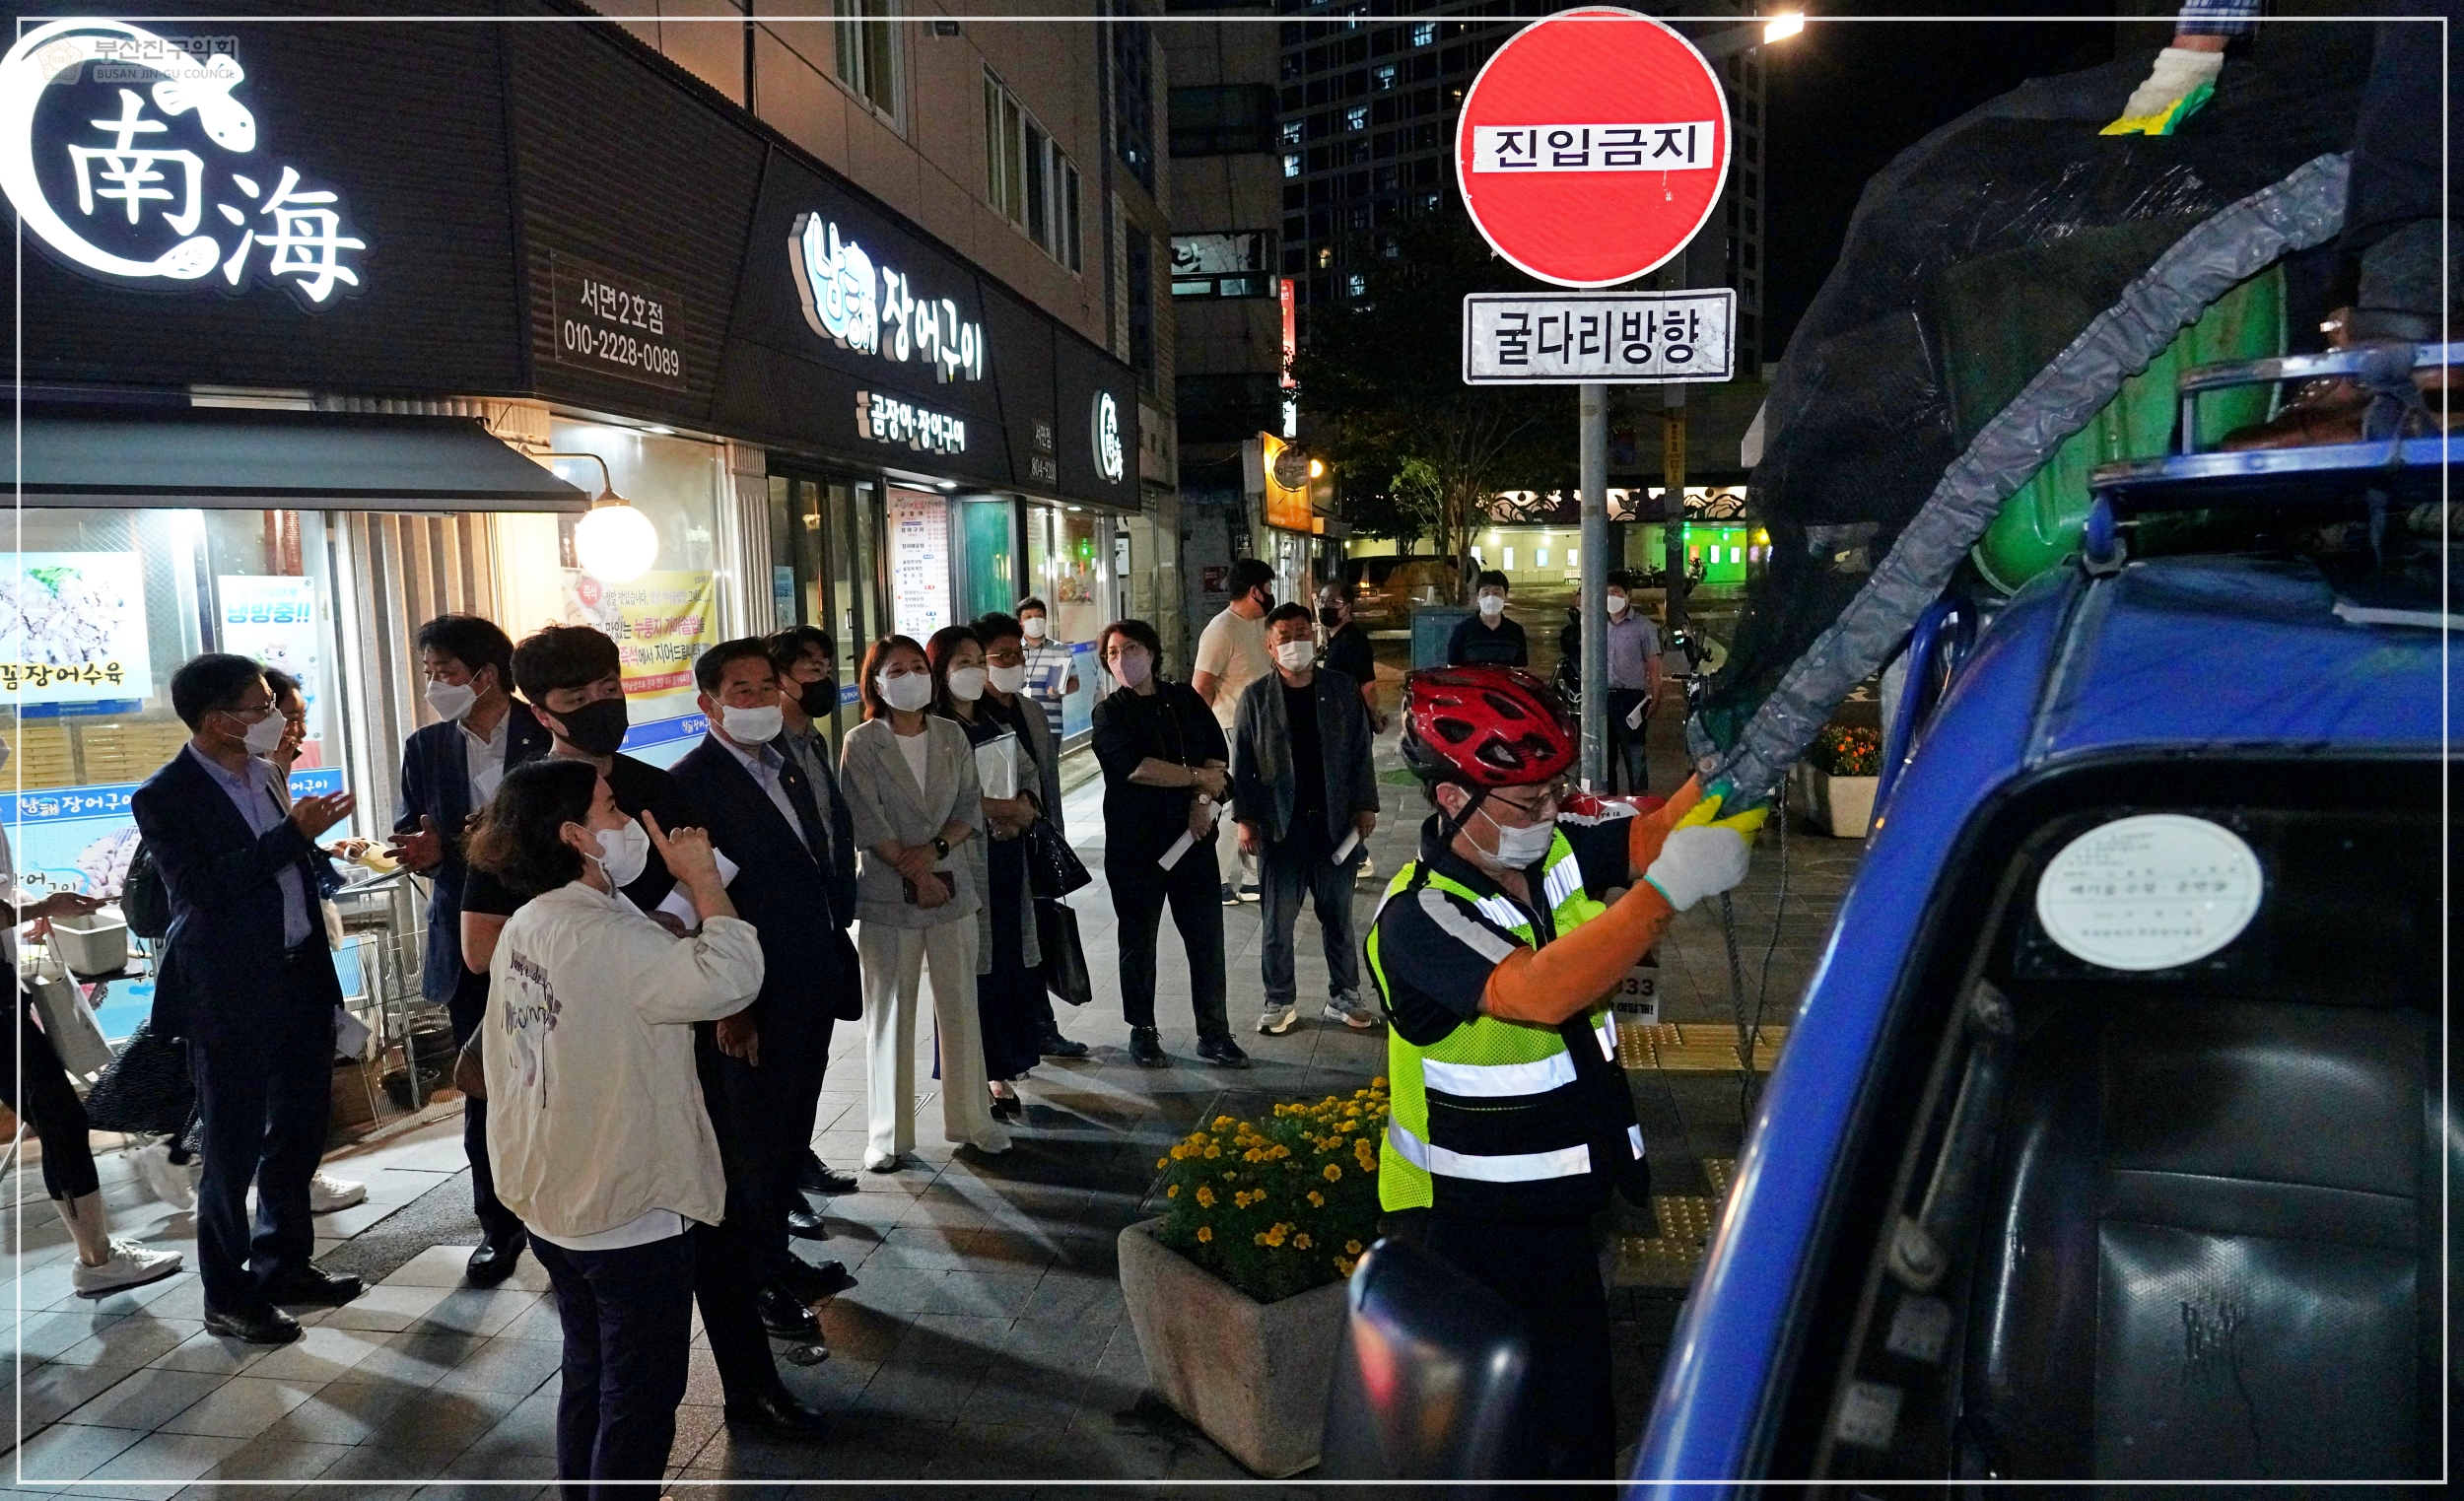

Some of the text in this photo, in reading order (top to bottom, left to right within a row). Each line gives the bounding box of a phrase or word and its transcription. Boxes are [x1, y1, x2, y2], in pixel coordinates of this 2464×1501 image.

[1495, 125, 1696, 169] 진입금지
[68, 89, 366, 302] 南海
[581, 279, 663, 335] 서면2호점
[882, 265, 983, 382] 장어구이
[1495, 308, 1699, 366] 굴다리방향
[565, 319, 679, 376] 010-2228-0089
[227, 602, 310, 623] 냉방중!!
[634, 617, 662, 640] 누룽지
[619, 646, 653, 668] 즉석에서
[0, 661, 124, 691] 꼼장어수육
[288, 779, 328, 792] 어구이
[14, 872, 45, 887] 어
[1620, 978, 1655, 996] 33
